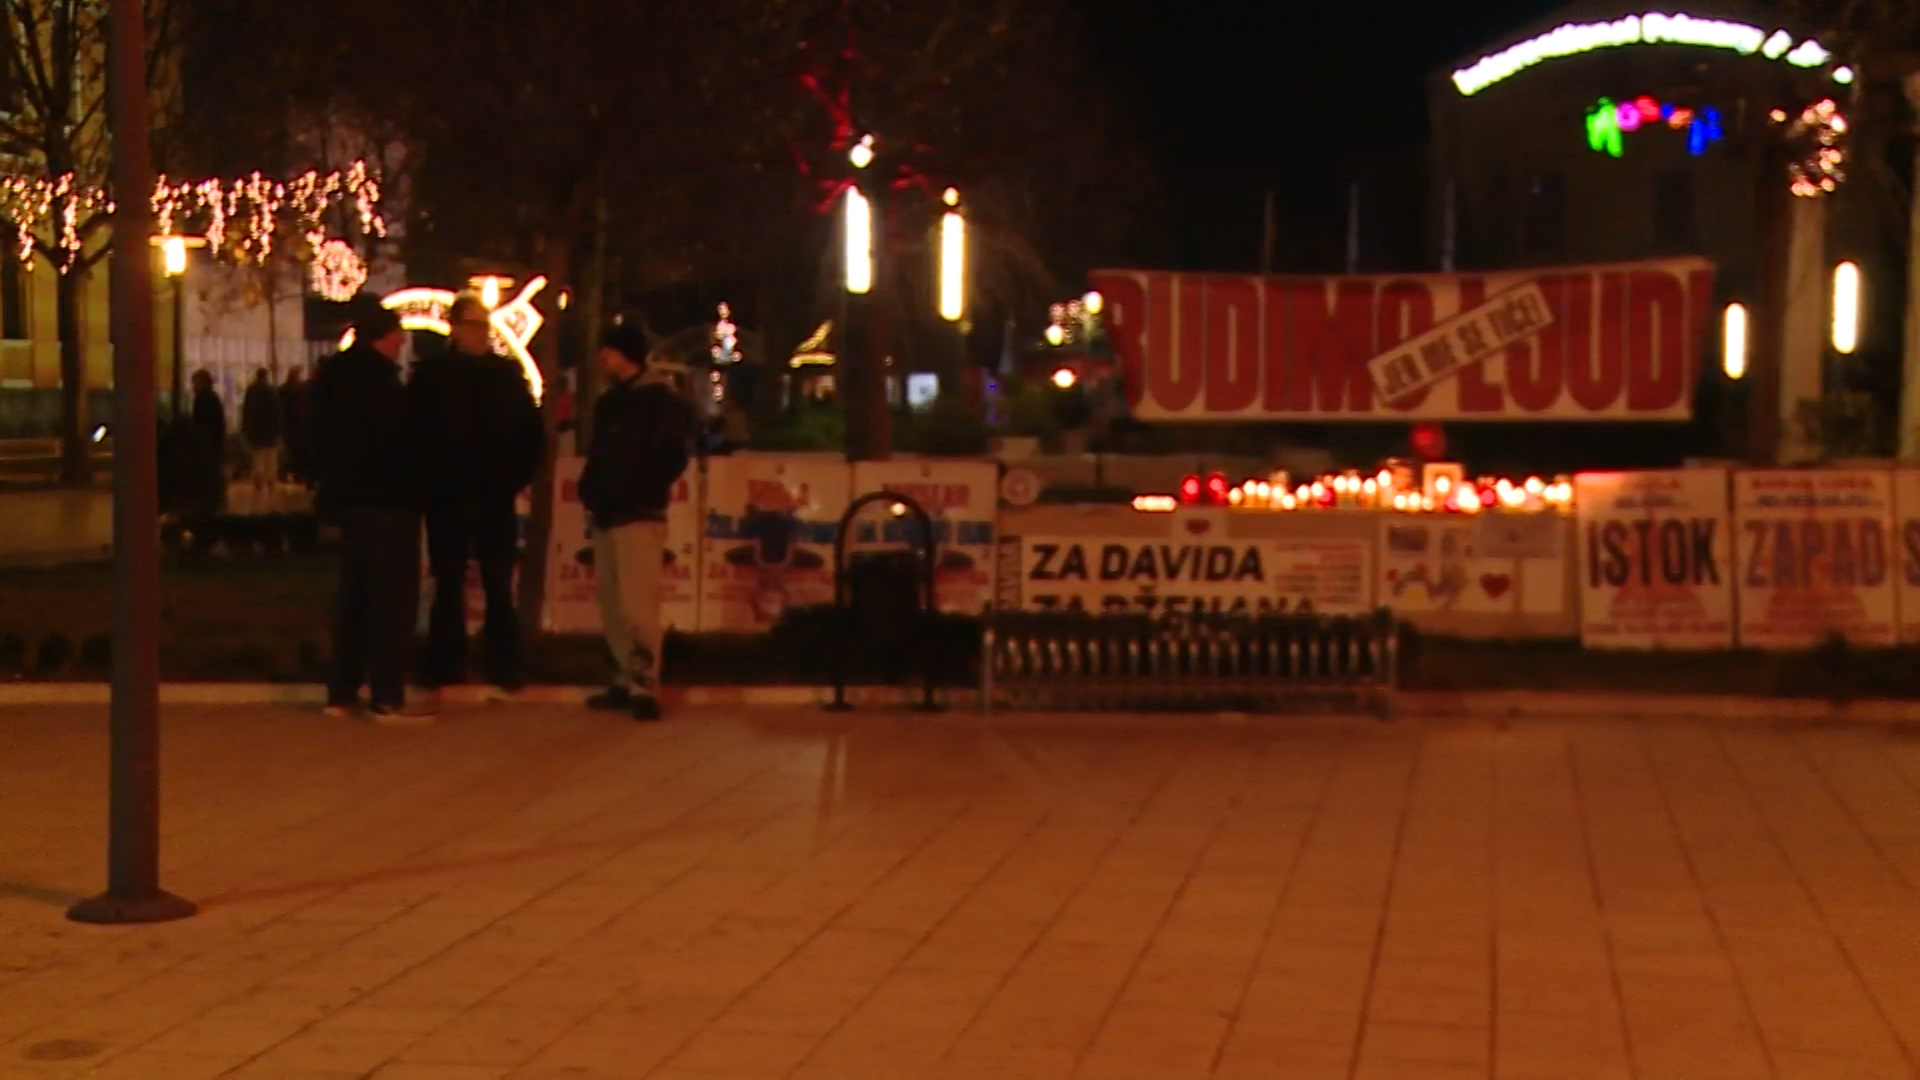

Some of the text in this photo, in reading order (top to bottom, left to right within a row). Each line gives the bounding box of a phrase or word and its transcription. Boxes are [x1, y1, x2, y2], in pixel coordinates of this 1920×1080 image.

[1090, 271, 1436, 413] BUDIMO
[1028, 543, 1088, 582] ZA
[1099, 543, 1264, 582] DAVIDA
[1586, 517, 1722, 588] ISTOK
[1743, 518, 1886, 589] ZAPAD
